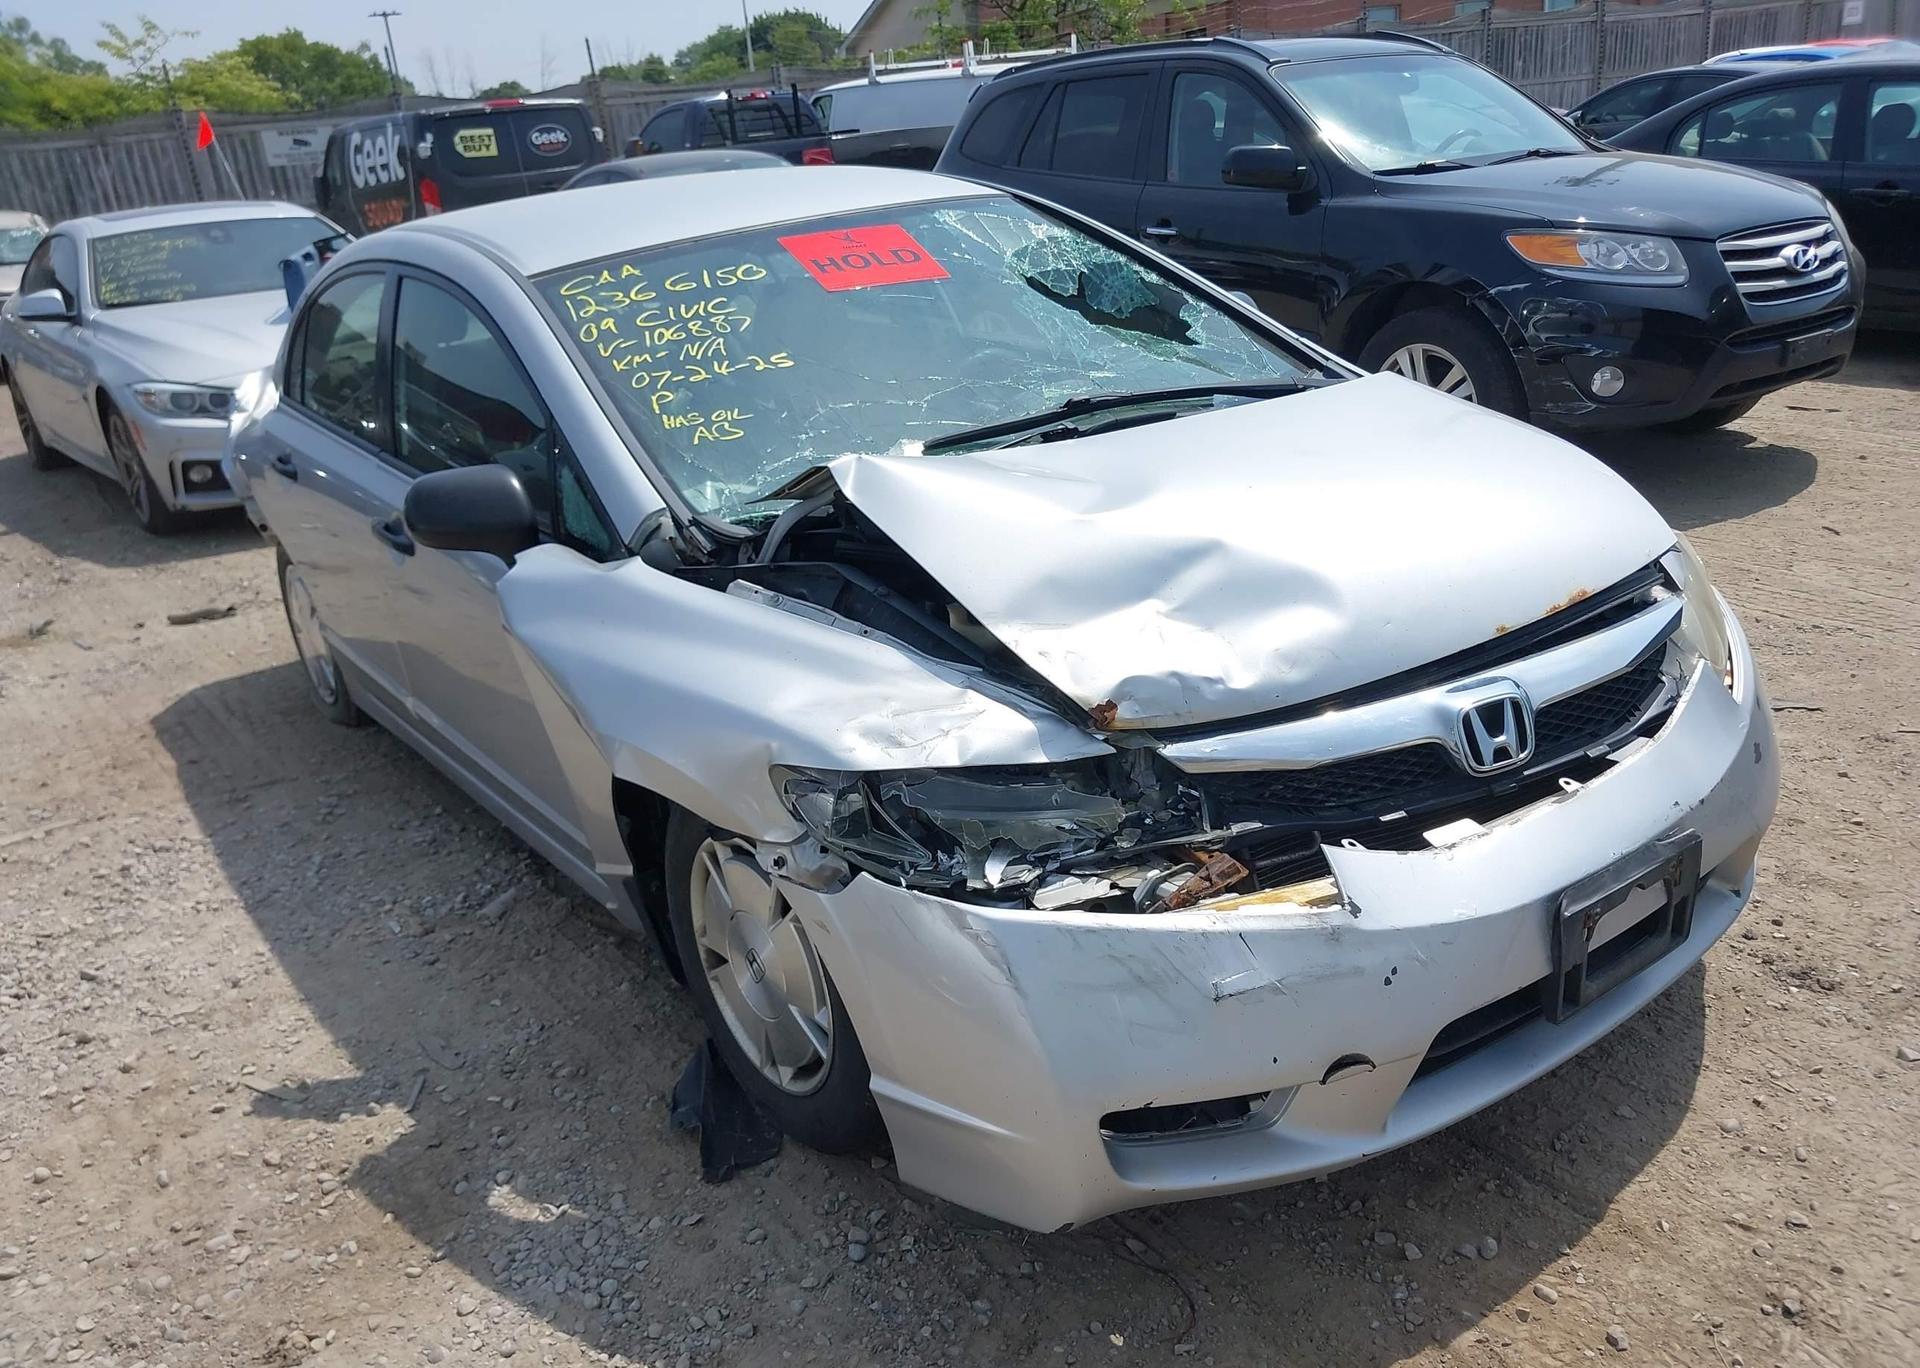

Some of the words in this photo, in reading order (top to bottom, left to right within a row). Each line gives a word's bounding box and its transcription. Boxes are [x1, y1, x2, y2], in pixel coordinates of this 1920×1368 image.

[459, 134, 493, 145] BEST
[463, 143, 491, 153] BUY
[531, 130, 568, 145] Geek
[350, 122, 406, 189] Geek
[809, 248, 922, 273] HOLD
[560, 264, 643, 296] CAA
[564, 281, 657, 323] 1236
[664, 263, 767, 292] 6150
[579, 317, 618, 342] 09
[635, 297, 737, 327] CIVIC
[651, 390, 674, 414] P
[662, 411, 705, 430] HAS
[711, 407, 754, 422] OIL
